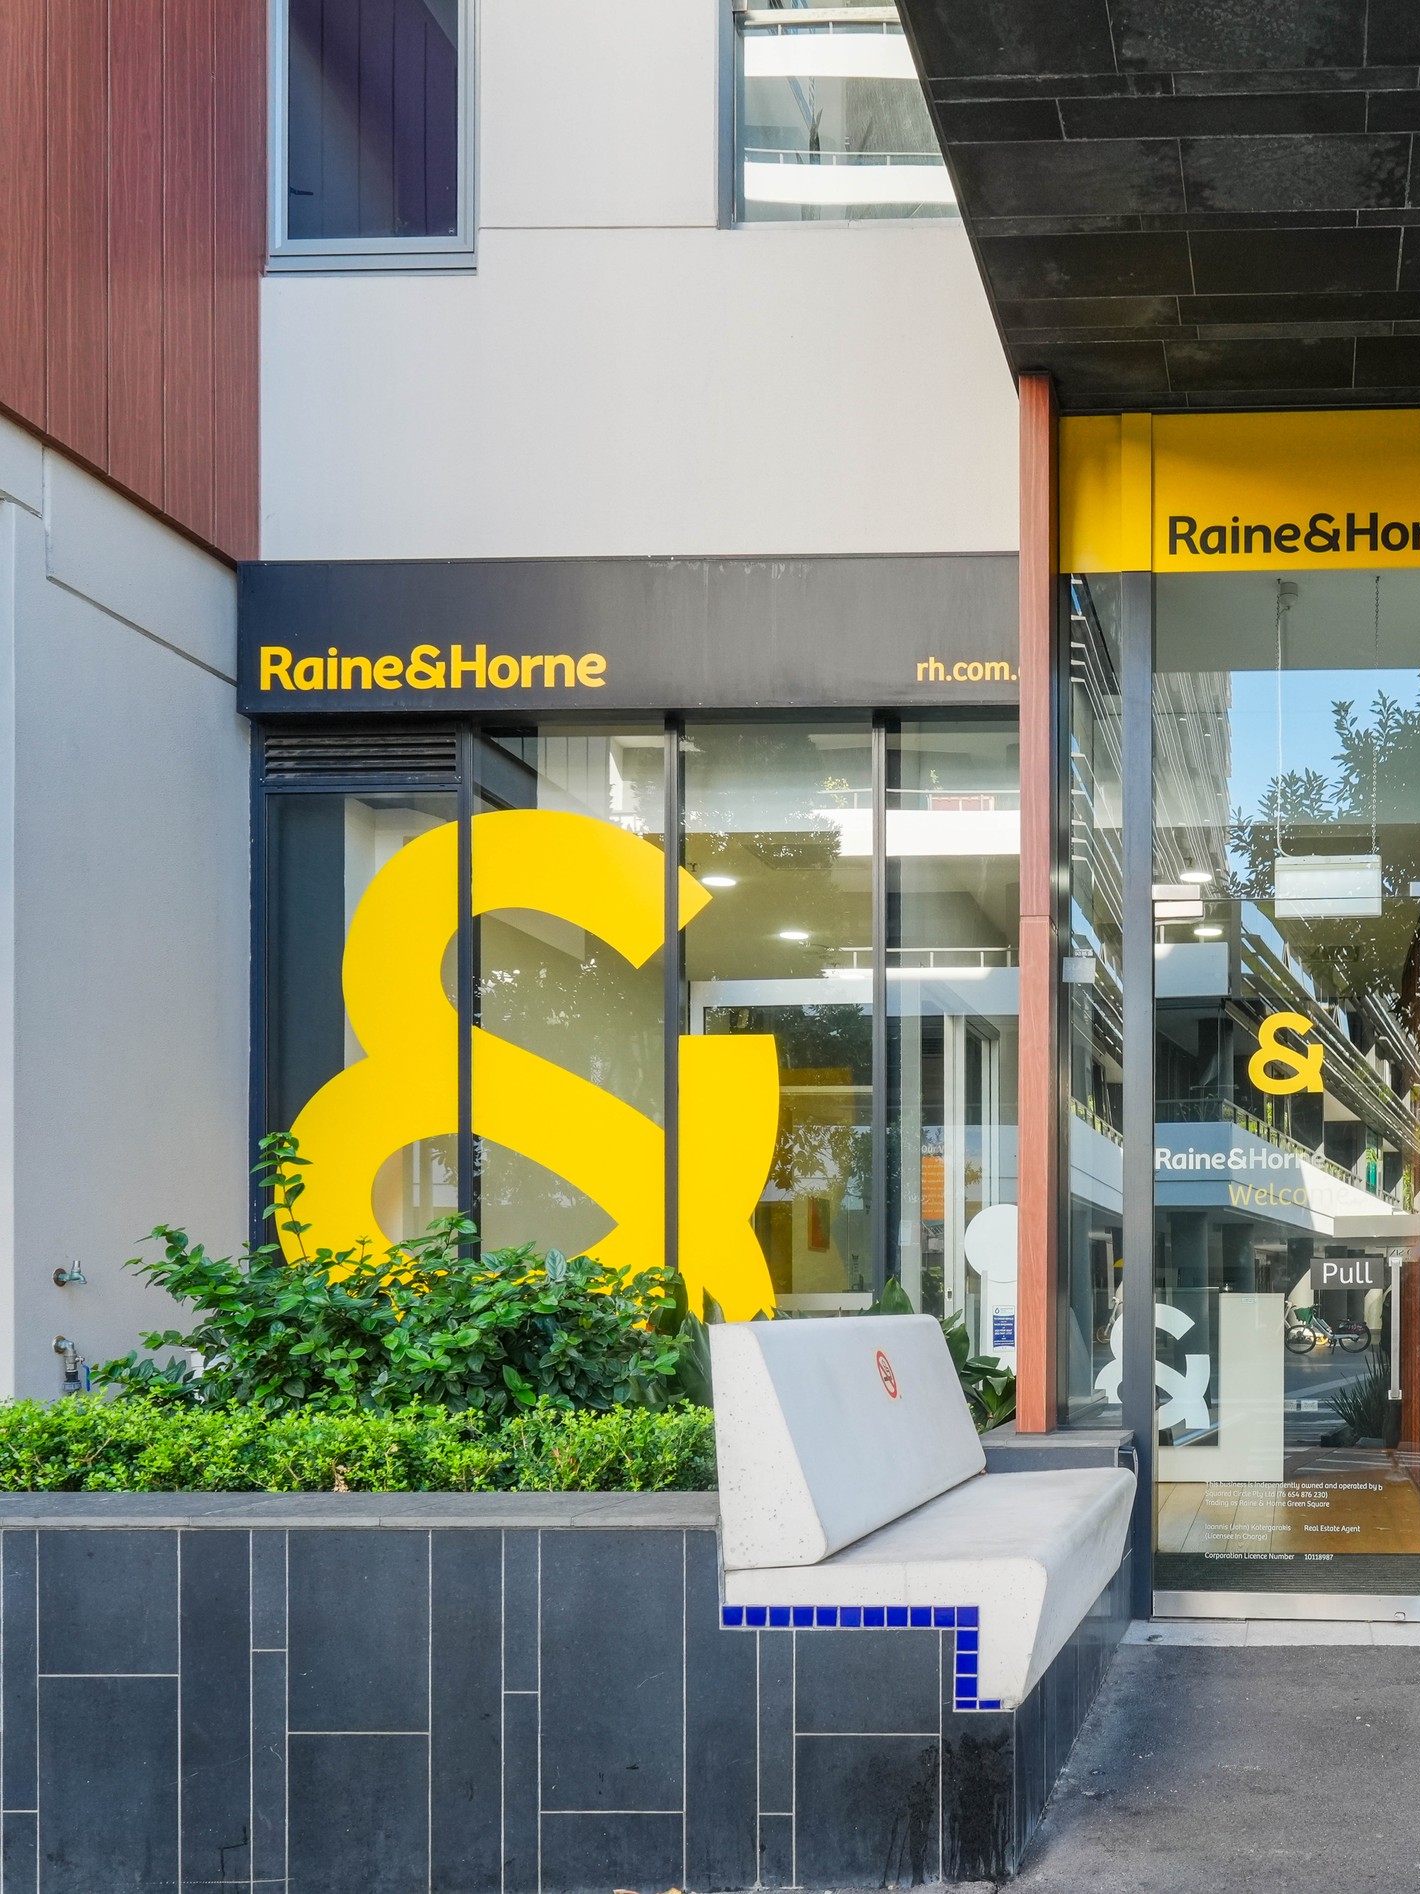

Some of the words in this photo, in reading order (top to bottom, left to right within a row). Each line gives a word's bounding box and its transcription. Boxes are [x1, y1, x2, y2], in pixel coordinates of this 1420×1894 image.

[259, 643, 607, 691] Raine&Horne
[917, 656, 1020, 681] rh.com.
[1155, 1148, 1326, 1170] Raine&Horne
[1323, 1261, 1373, 1284] Pull
[1368, 1483, 1377, 1491] by
[1313, 1491, 1328, 1499] 230)
[1206, 1499, 1229, 1507] Trading
[1341, 1525, 1361, 1534] Agent
[1204, 1552, 1243, 1560] Corporation
[1244, 1552, 1268, 1560] Licence
